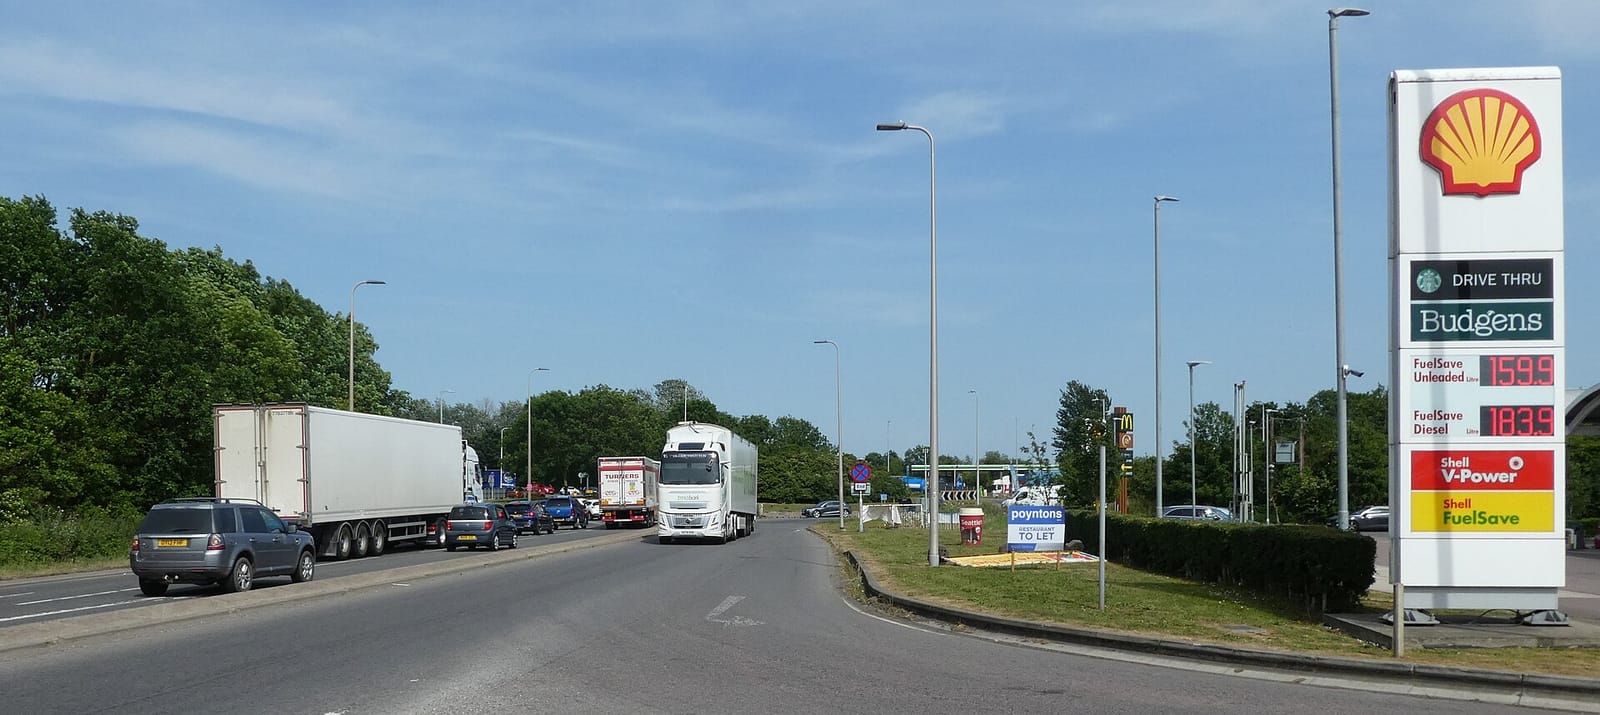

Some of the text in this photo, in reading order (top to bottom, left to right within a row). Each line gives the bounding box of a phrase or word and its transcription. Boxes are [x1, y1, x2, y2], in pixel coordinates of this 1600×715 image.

[1452, 273, 1542, 287] DRIVE THRU
[1420, 309, 1542, 337] Budgens
[1414, 358, 1463, 369] FuelSave
[1414, 371, 1465, 383] Unleaded
[1489, 356, 1554, 386] 159.9
[1414, 410, 1463, 421] FuelSave
[1489, 407, 1554, 436] 183.9
[1414, 423, 1449, 435] Diesel
[1440, 457, 1470, 468] Shell
[1441, 469, 1518, 484] V-Power
[1443, 498, 1472, 509] Shell
[1011, 509, 1063, 521] poyntons
[1443, 510, 1520, 525] FuelSave
[1018, 532, 1055, 541] TO LET
